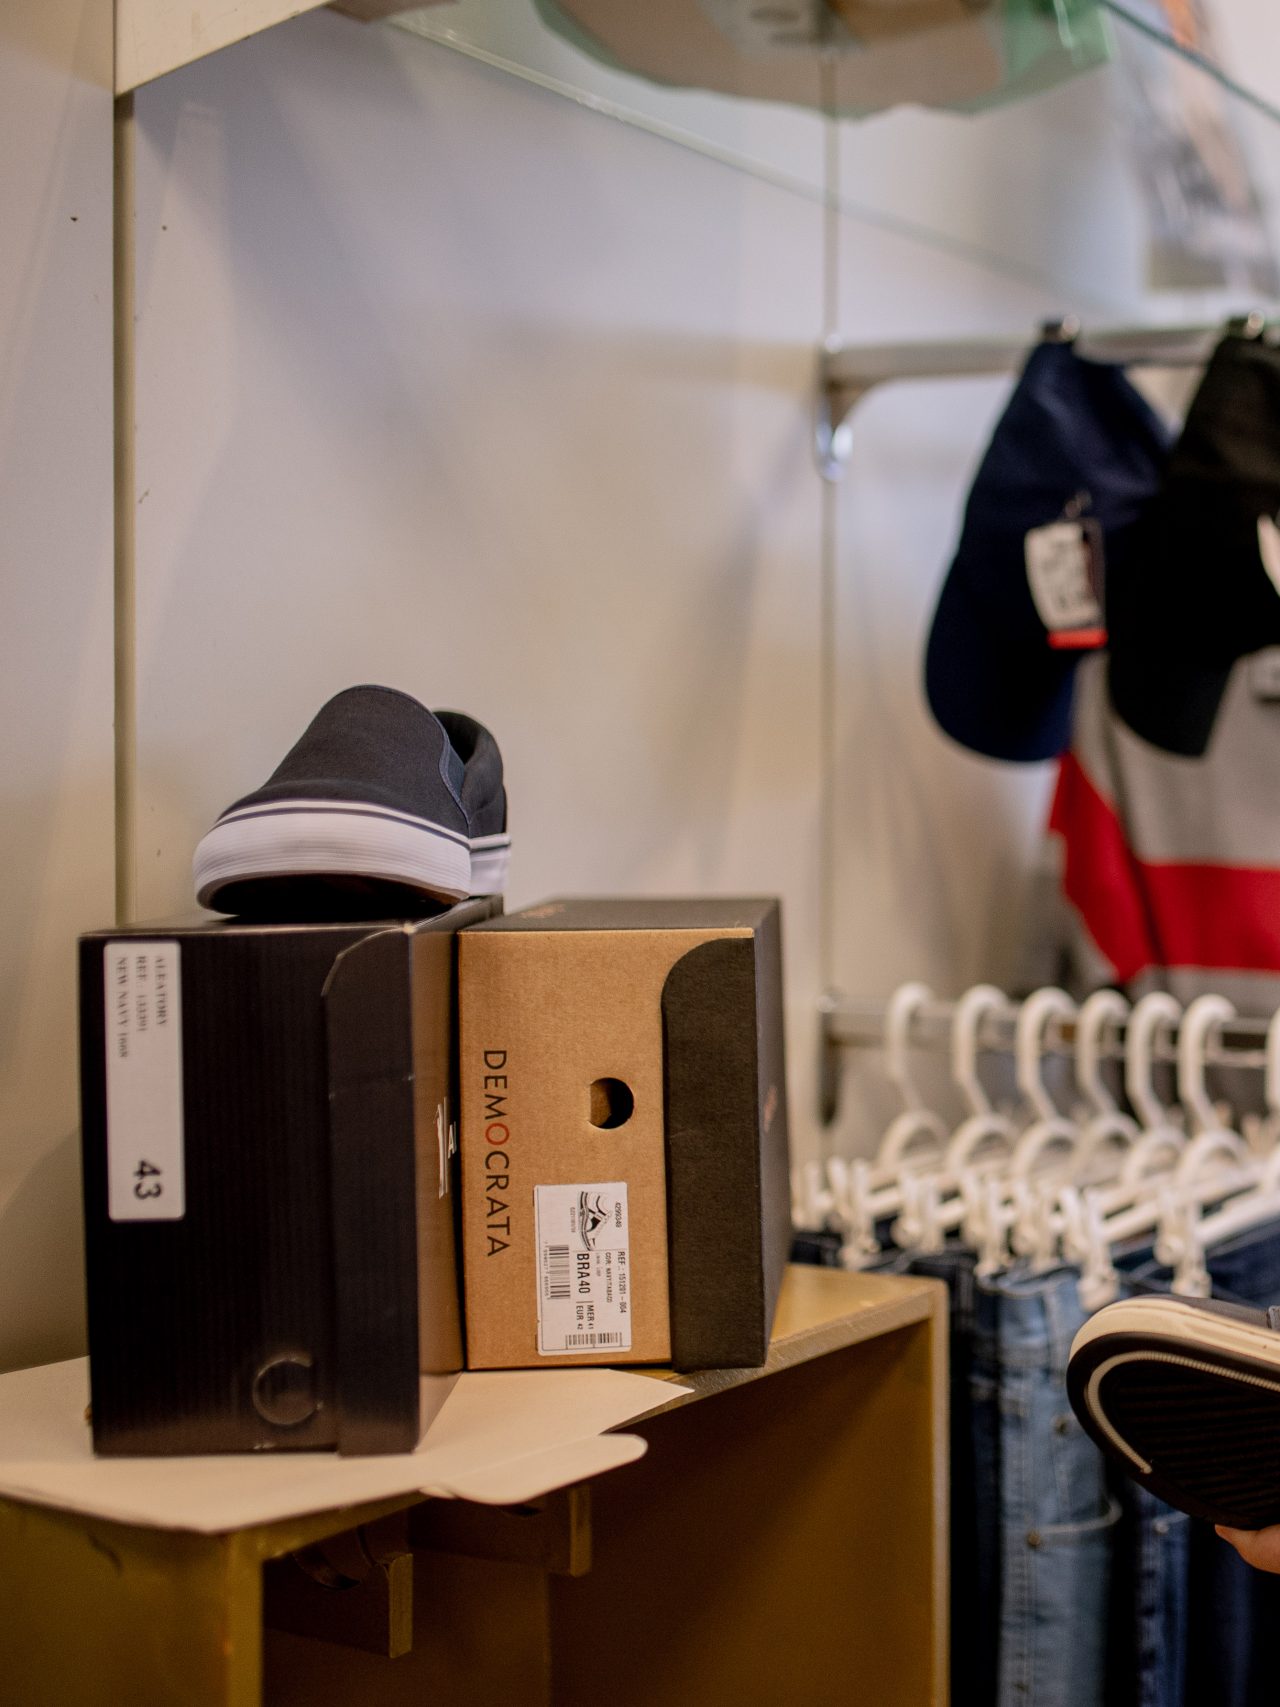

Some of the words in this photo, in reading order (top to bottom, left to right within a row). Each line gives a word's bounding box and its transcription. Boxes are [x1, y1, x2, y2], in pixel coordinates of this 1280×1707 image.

[117, 957, 128, 986] NEW
[117, 991, 129, 1027] NAVY
[483, 1050, 511, 1257] DEMOCRATA
[133, 1160, 162, 1200] 43
[576, 1305, 584, 1320] EUR
[587, 1304, 595, 1321] MER
